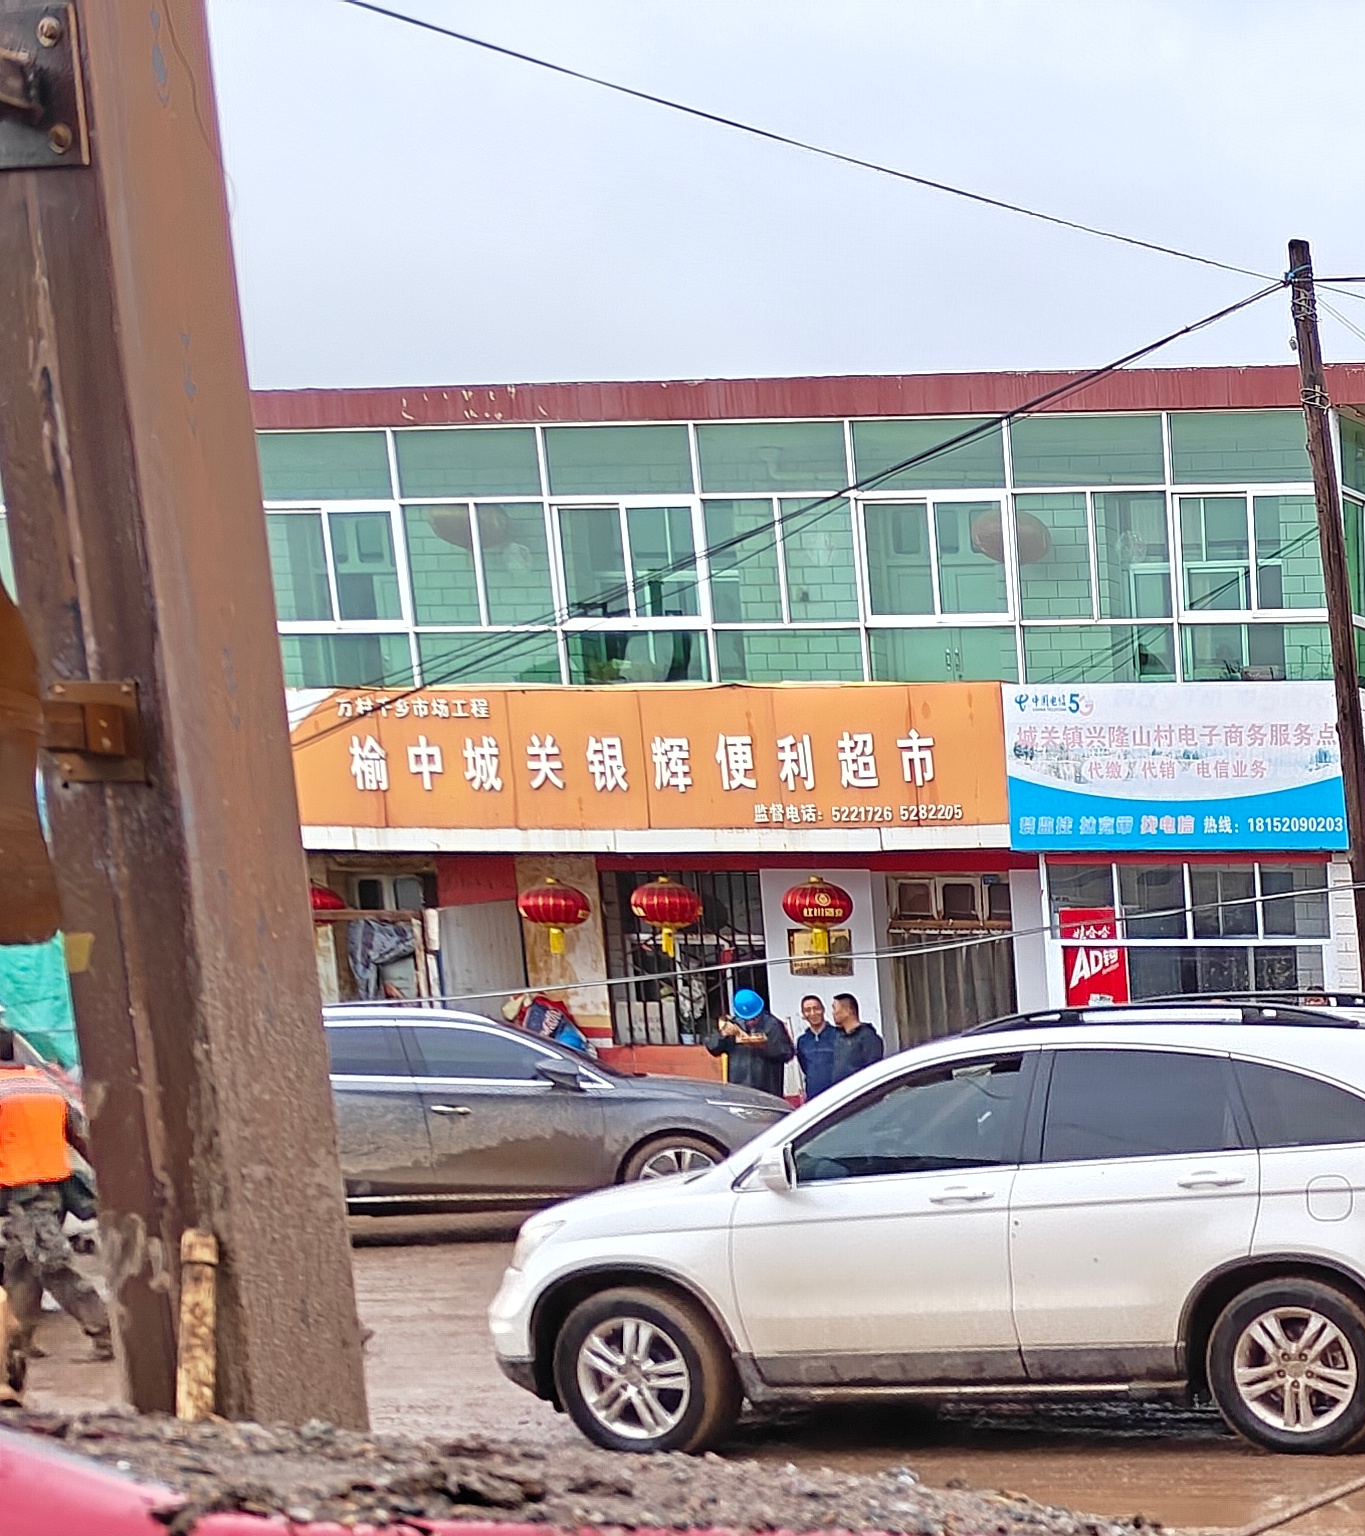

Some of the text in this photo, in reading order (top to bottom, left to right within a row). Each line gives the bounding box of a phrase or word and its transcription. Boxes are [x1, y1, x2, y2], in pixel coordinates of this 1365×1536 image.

[1068, 693, 1094, 717] 5G
[1016, 723, 1337, 748] 城关镇兴隆山村电子商务服务点
[349, 729, 936, 793] 榆中城关银辉便利超市
[1087, 759, 1267, 780] 代缴 代销 电信业务
[831, 805, 893, 822] 5221726
[900, 804, 962, 820] 5282205
[1247, 817, 1343, 833] 18152090203
